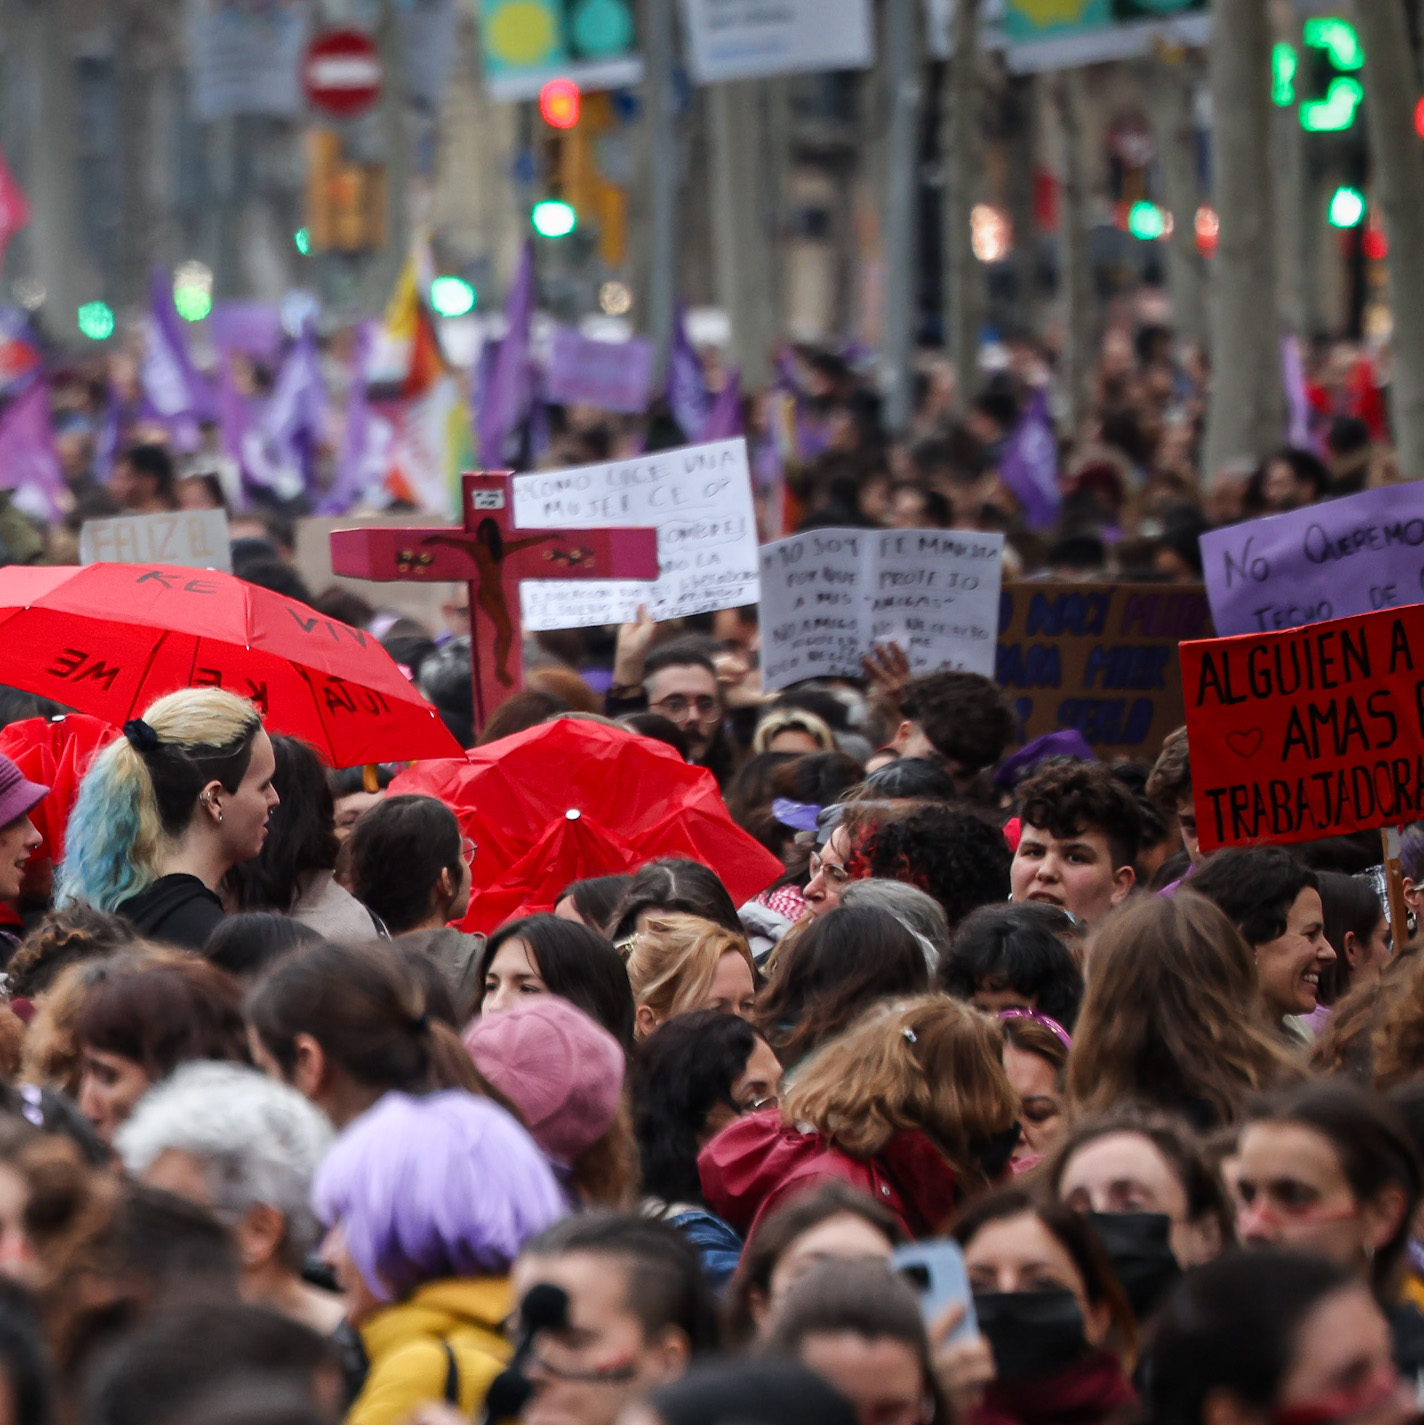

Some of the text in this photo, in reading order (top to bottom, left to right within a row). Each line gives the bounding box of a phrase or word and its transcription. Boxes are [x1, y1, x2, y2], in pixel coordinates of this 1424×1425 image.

[136, 569, 223, 594] KE
[1388, 618, 1414, 674] A
[1281, 689, 1399, 763] AMAS
